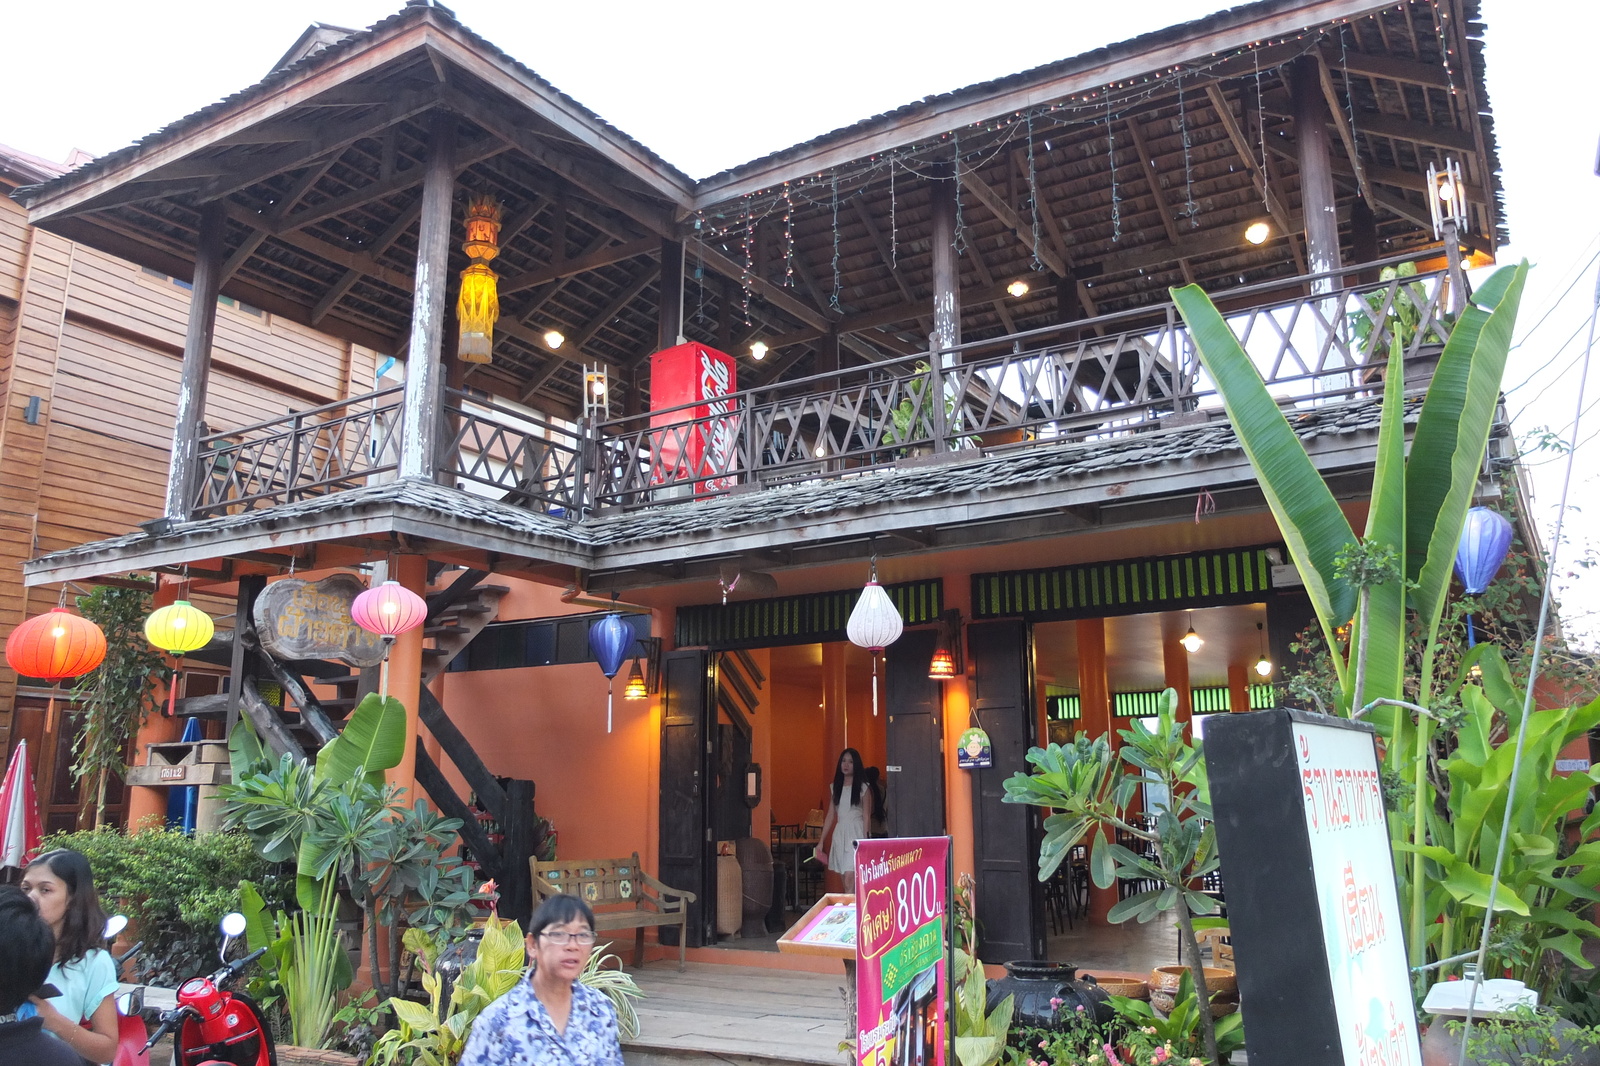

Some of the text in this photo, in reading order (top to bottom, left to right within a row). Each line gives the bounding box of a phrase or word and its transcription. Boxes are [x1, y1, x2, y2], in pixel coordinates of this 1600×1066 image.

[1299, 734, 1382, 831] ร้านอาหาร
[862, 901, 893, 947] พิเศษ!
[896, 865, 937, 933] 800
